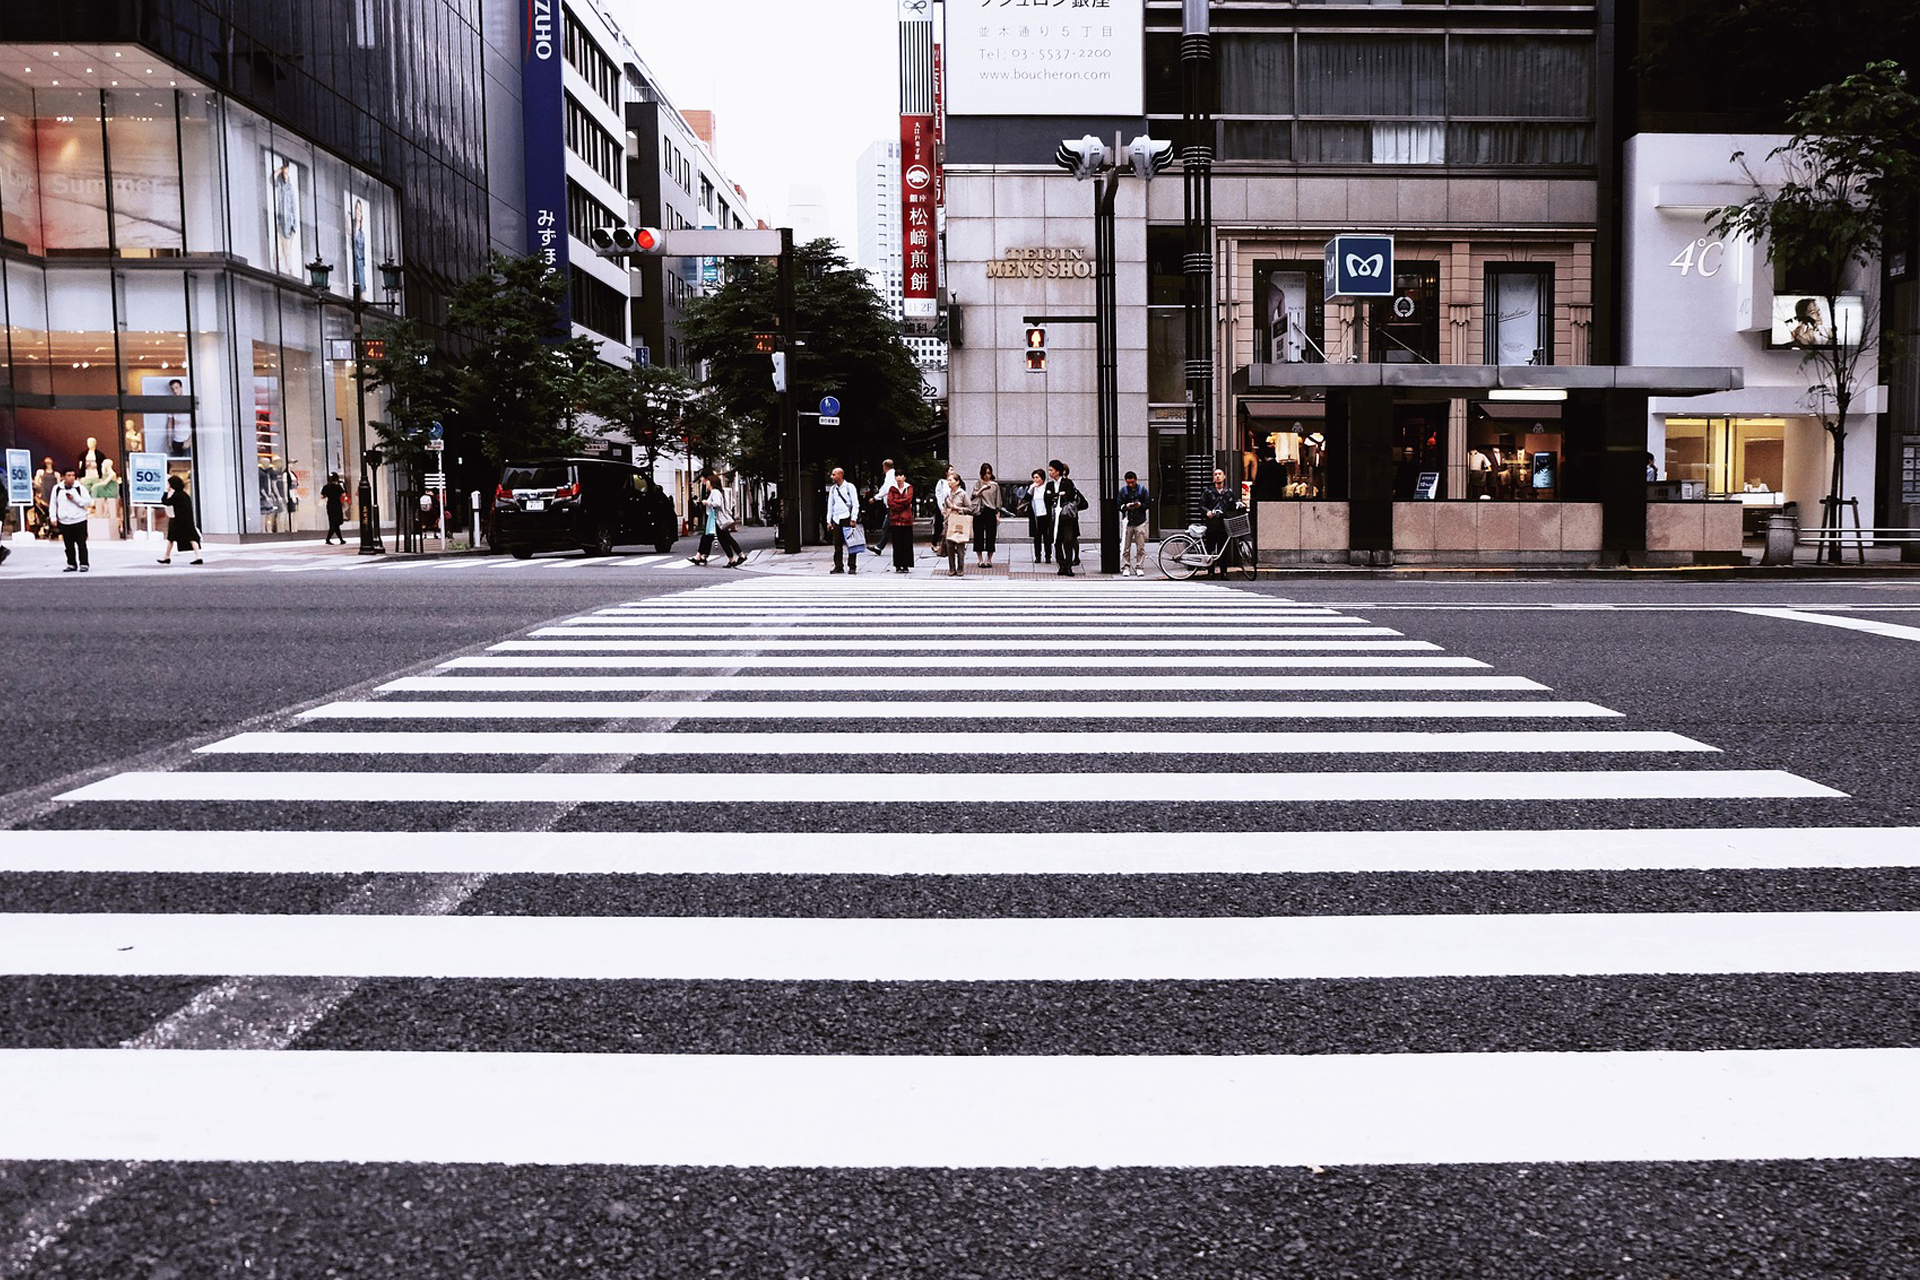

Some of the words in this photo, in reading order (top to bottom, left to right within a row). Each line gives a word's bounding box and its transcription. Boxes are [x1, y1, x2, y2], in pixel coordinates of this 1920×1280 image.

[979, 68, 1111, 80] www.boucheron.com
[1005, 248, 1084, 260] TEIJIN
[987, 261, 1044, 278] MEN'S
[921, 303, 933, 312] 2F
[922, 386, 937, 397] 22
[136, 471, 161, 482] 50%
